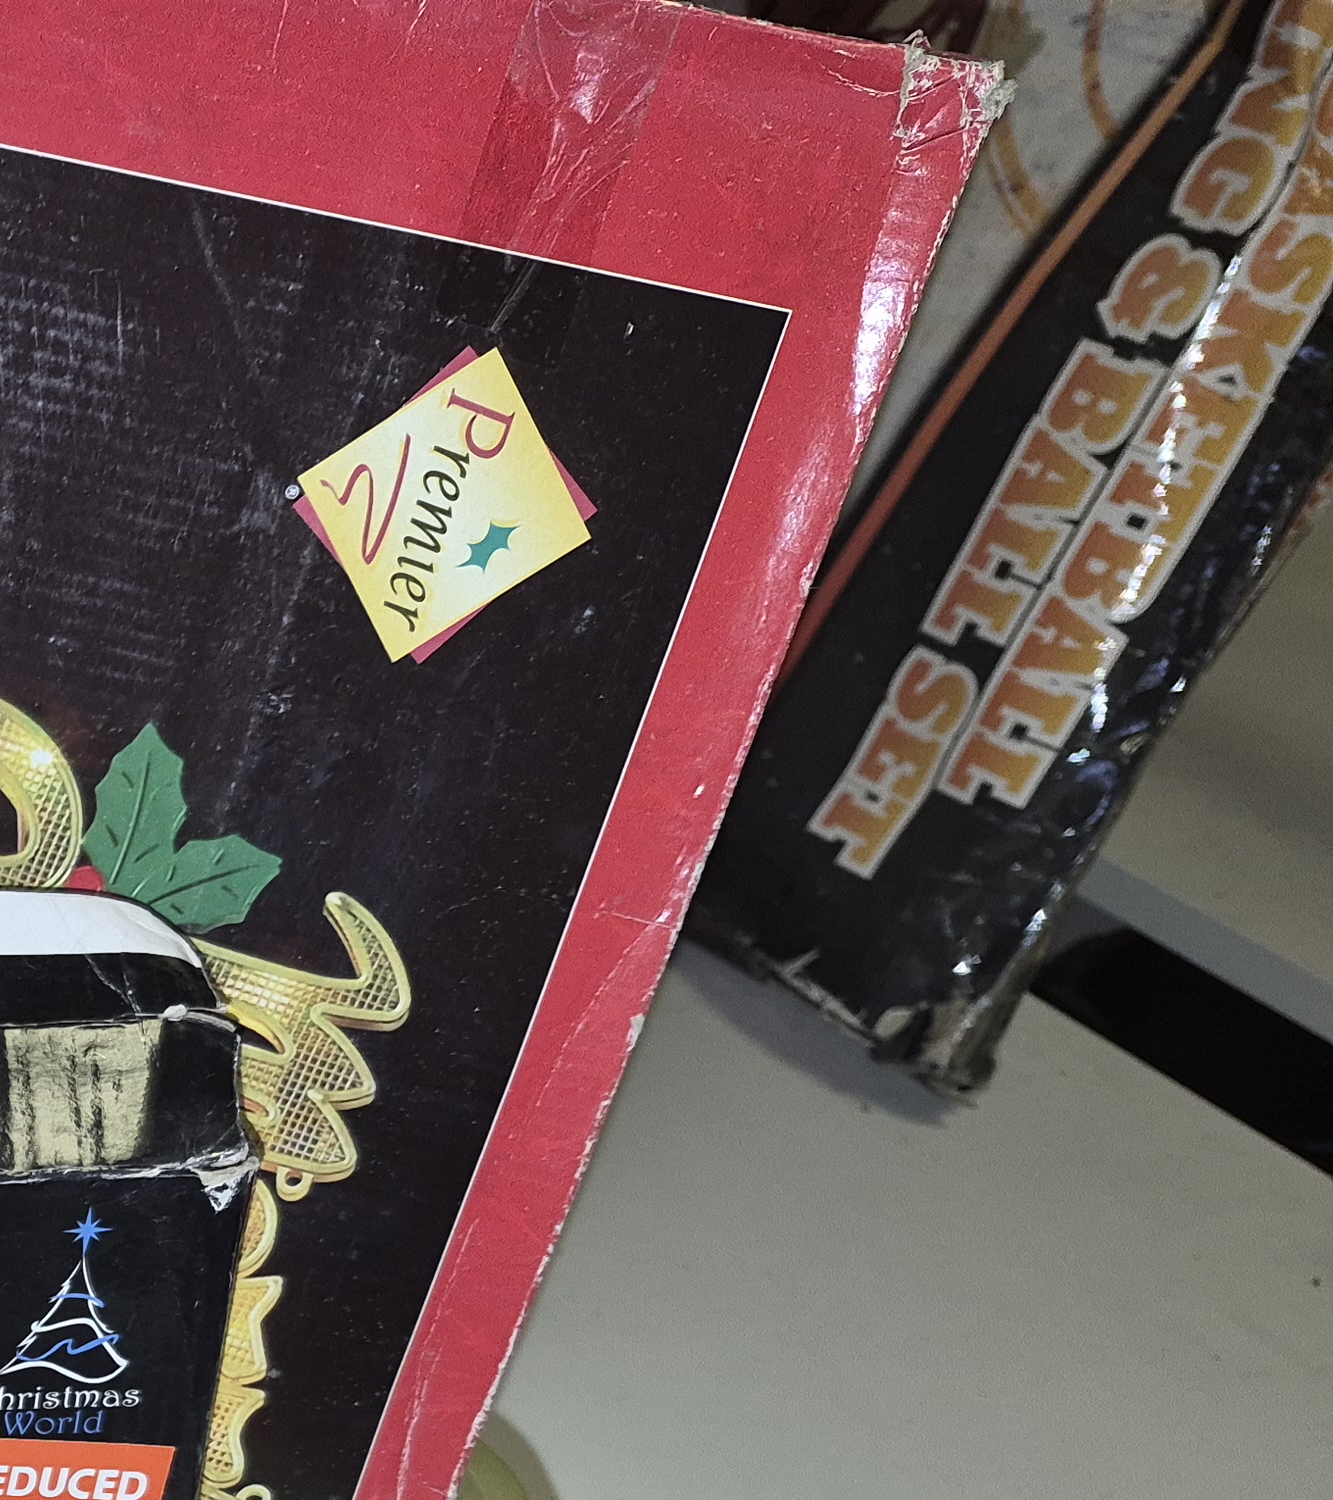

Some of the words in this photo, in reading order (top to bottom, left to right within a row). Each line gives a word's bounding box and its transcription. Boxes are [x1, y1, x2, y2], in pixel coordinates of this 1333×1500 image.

[1097, 232, 1224, 344] &
[384, 388, 515, 632] Premier
[918, 338, 1167, 650] BALL
[939, 70, 1333, 808] ASKETBALL
[807, 644, 979, 880] SET
[4, 1410, 104, 1435] World
